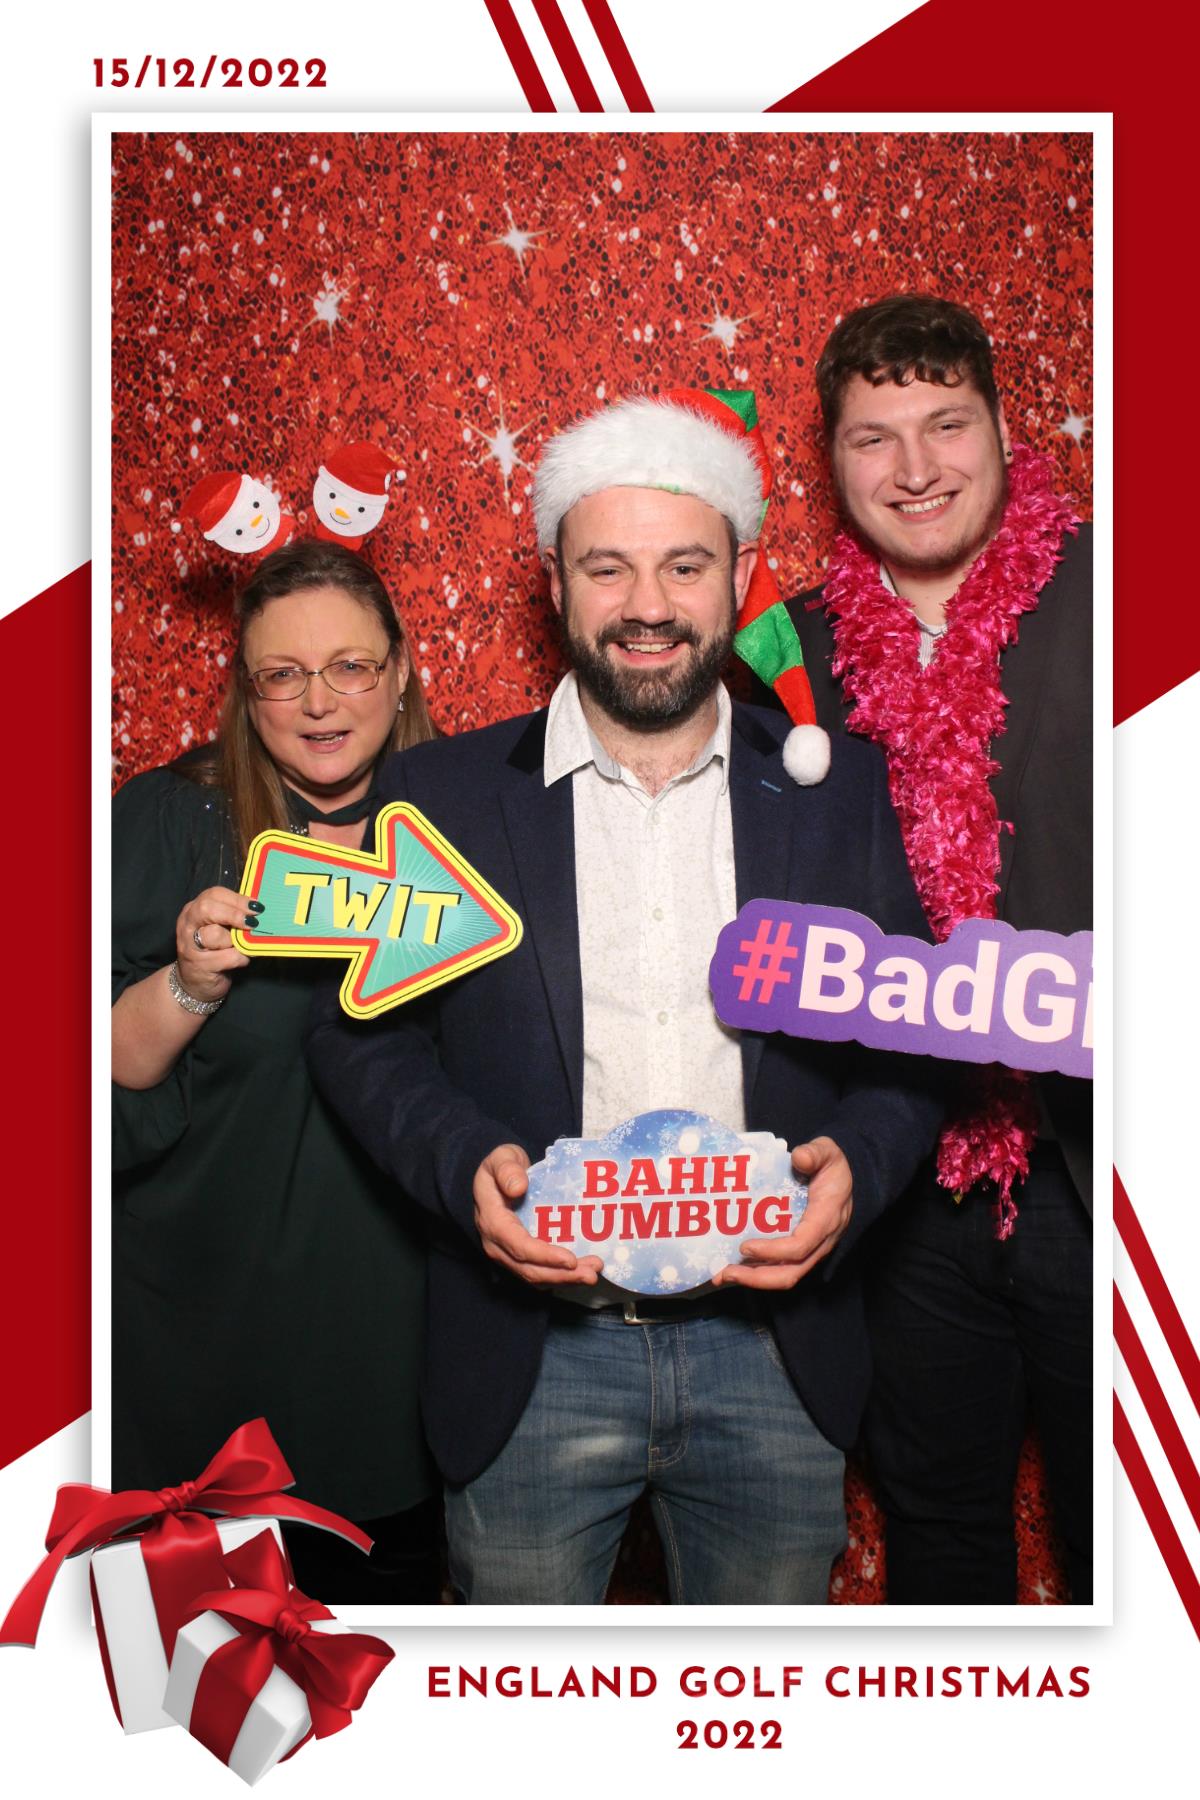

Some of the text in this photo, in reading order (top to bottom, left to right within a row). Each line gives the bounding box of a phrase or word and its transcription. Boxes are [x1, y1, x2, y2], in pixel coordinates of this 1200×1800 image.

[284, 871, 462, 945] TWIT
[582, 1154, 750, 1199] BAHH
[534, 1195, 793, 1243] HUMBUG
